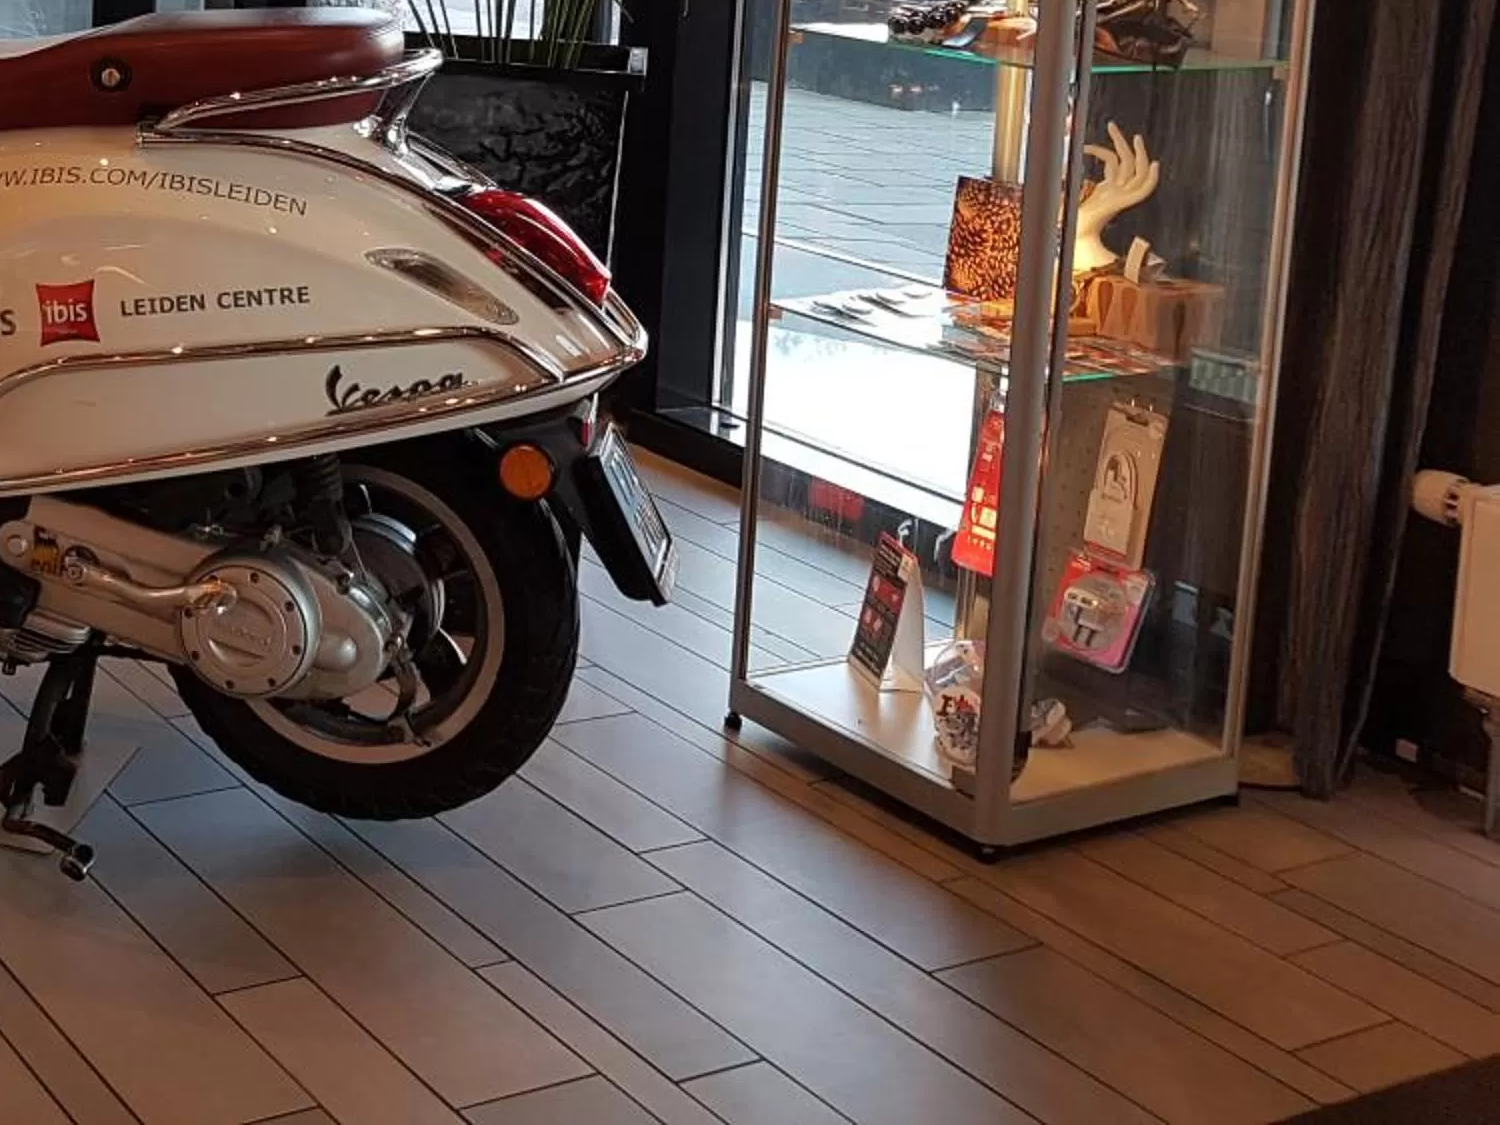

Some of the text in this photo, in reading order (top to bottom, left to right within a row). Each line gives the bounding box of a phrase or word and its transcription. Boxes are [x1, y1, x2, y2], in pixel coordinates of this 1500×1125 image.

[42, 299, 88, 325] ibis
[120, 286, 310, 316] LEIDEN CENTRE
[324, 364, 464, 417] Vespa
